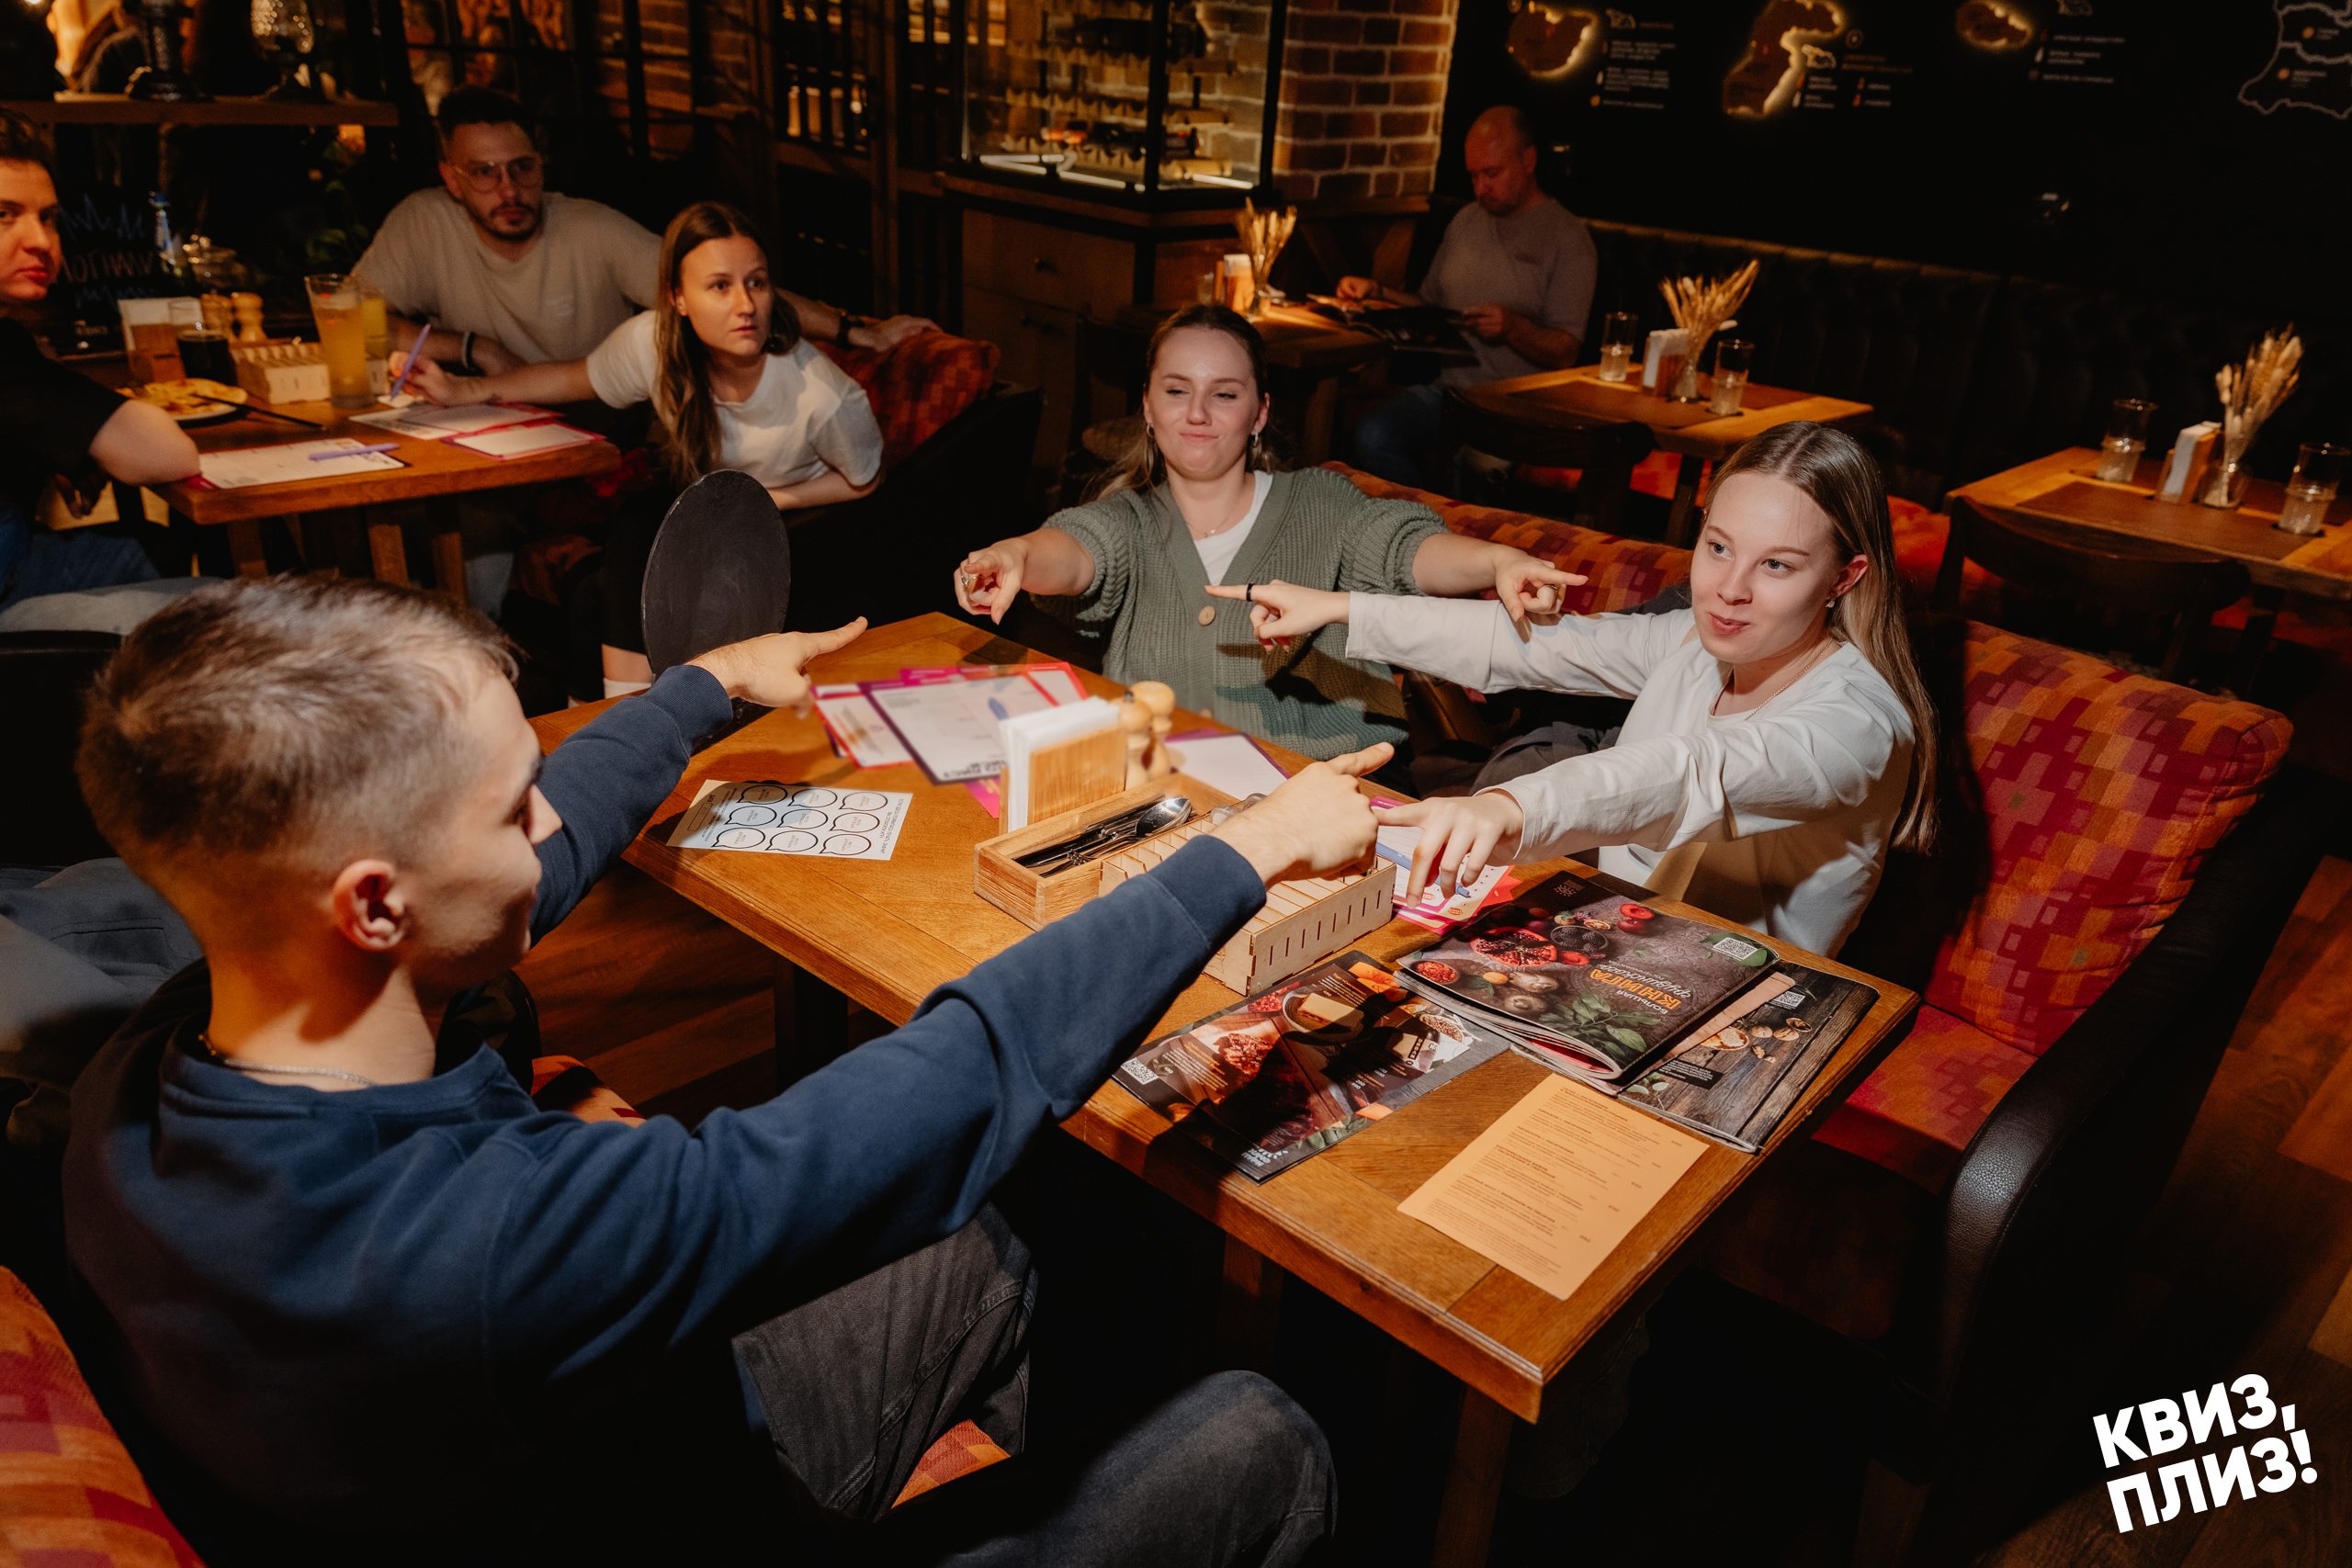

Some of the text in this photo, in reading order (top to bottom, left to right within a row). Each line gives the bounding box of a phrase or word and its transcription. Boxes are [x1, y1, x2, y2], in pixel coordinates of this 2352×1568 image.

[1589, 968, 1682, 1010] КНИГА
[1596, 964, 1691, 999] грузинского
[1616, 989, 1668, 1015] БОЛЬШАЯ
[1409, 1037, 1423, 1059] URBAN
